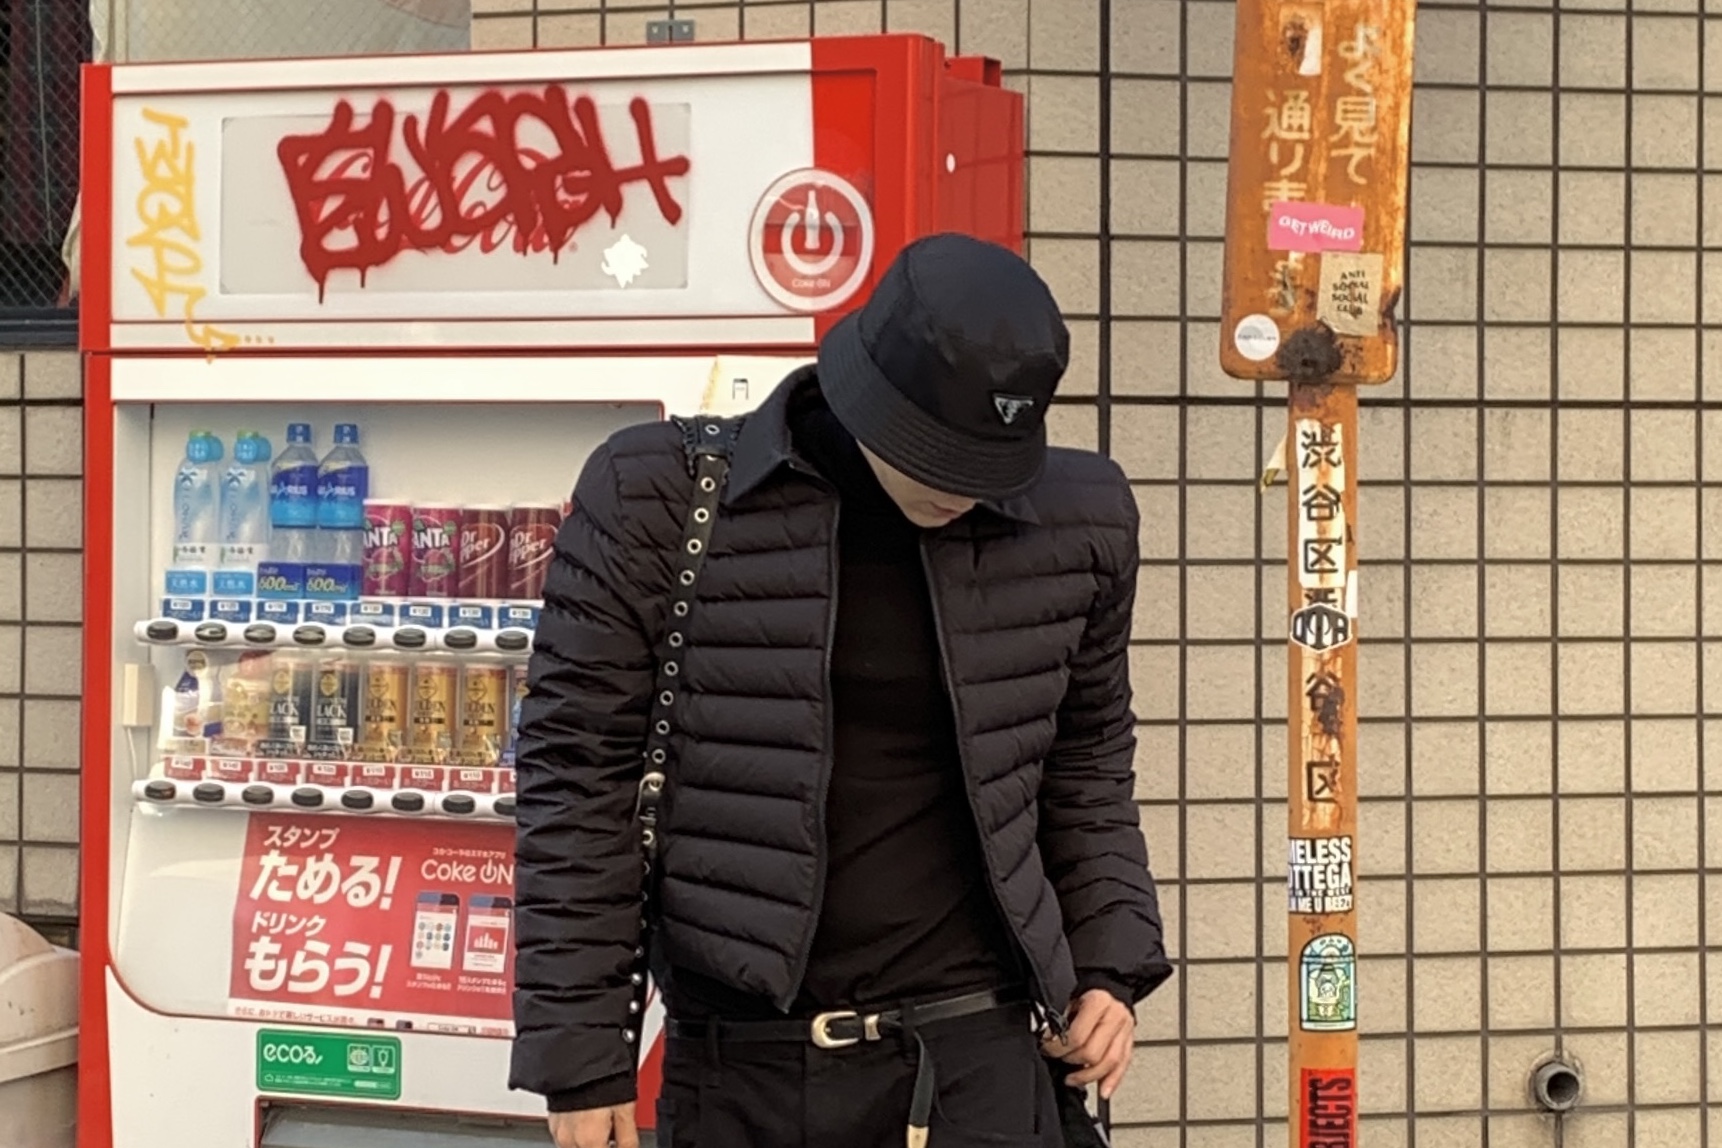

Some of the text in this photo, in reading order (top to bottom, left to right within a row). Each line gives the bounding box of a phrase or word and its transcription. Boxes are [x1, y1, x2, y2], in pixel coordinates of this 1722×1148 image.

[1278, 214, 1356, 240] GET WEIRD
[1340, 269, 1366, 280] ANTI
[1301, 429, 1342, 575] 渋谷区
[363, 526, 399, 548] ANTA
[412, 528, 450, 548] ANTA
[270, 702, 300, 716] LACK
[316, 703, 347, 718] LACK
[263, 825, 340, 850] スタンプ
[249, 849, 403, 911] ためる!
[420, 858, 515, 885] Coke ON
[251, 910, 327, 937] ドリンク
[244, 935, 393, 1000] もらう!
